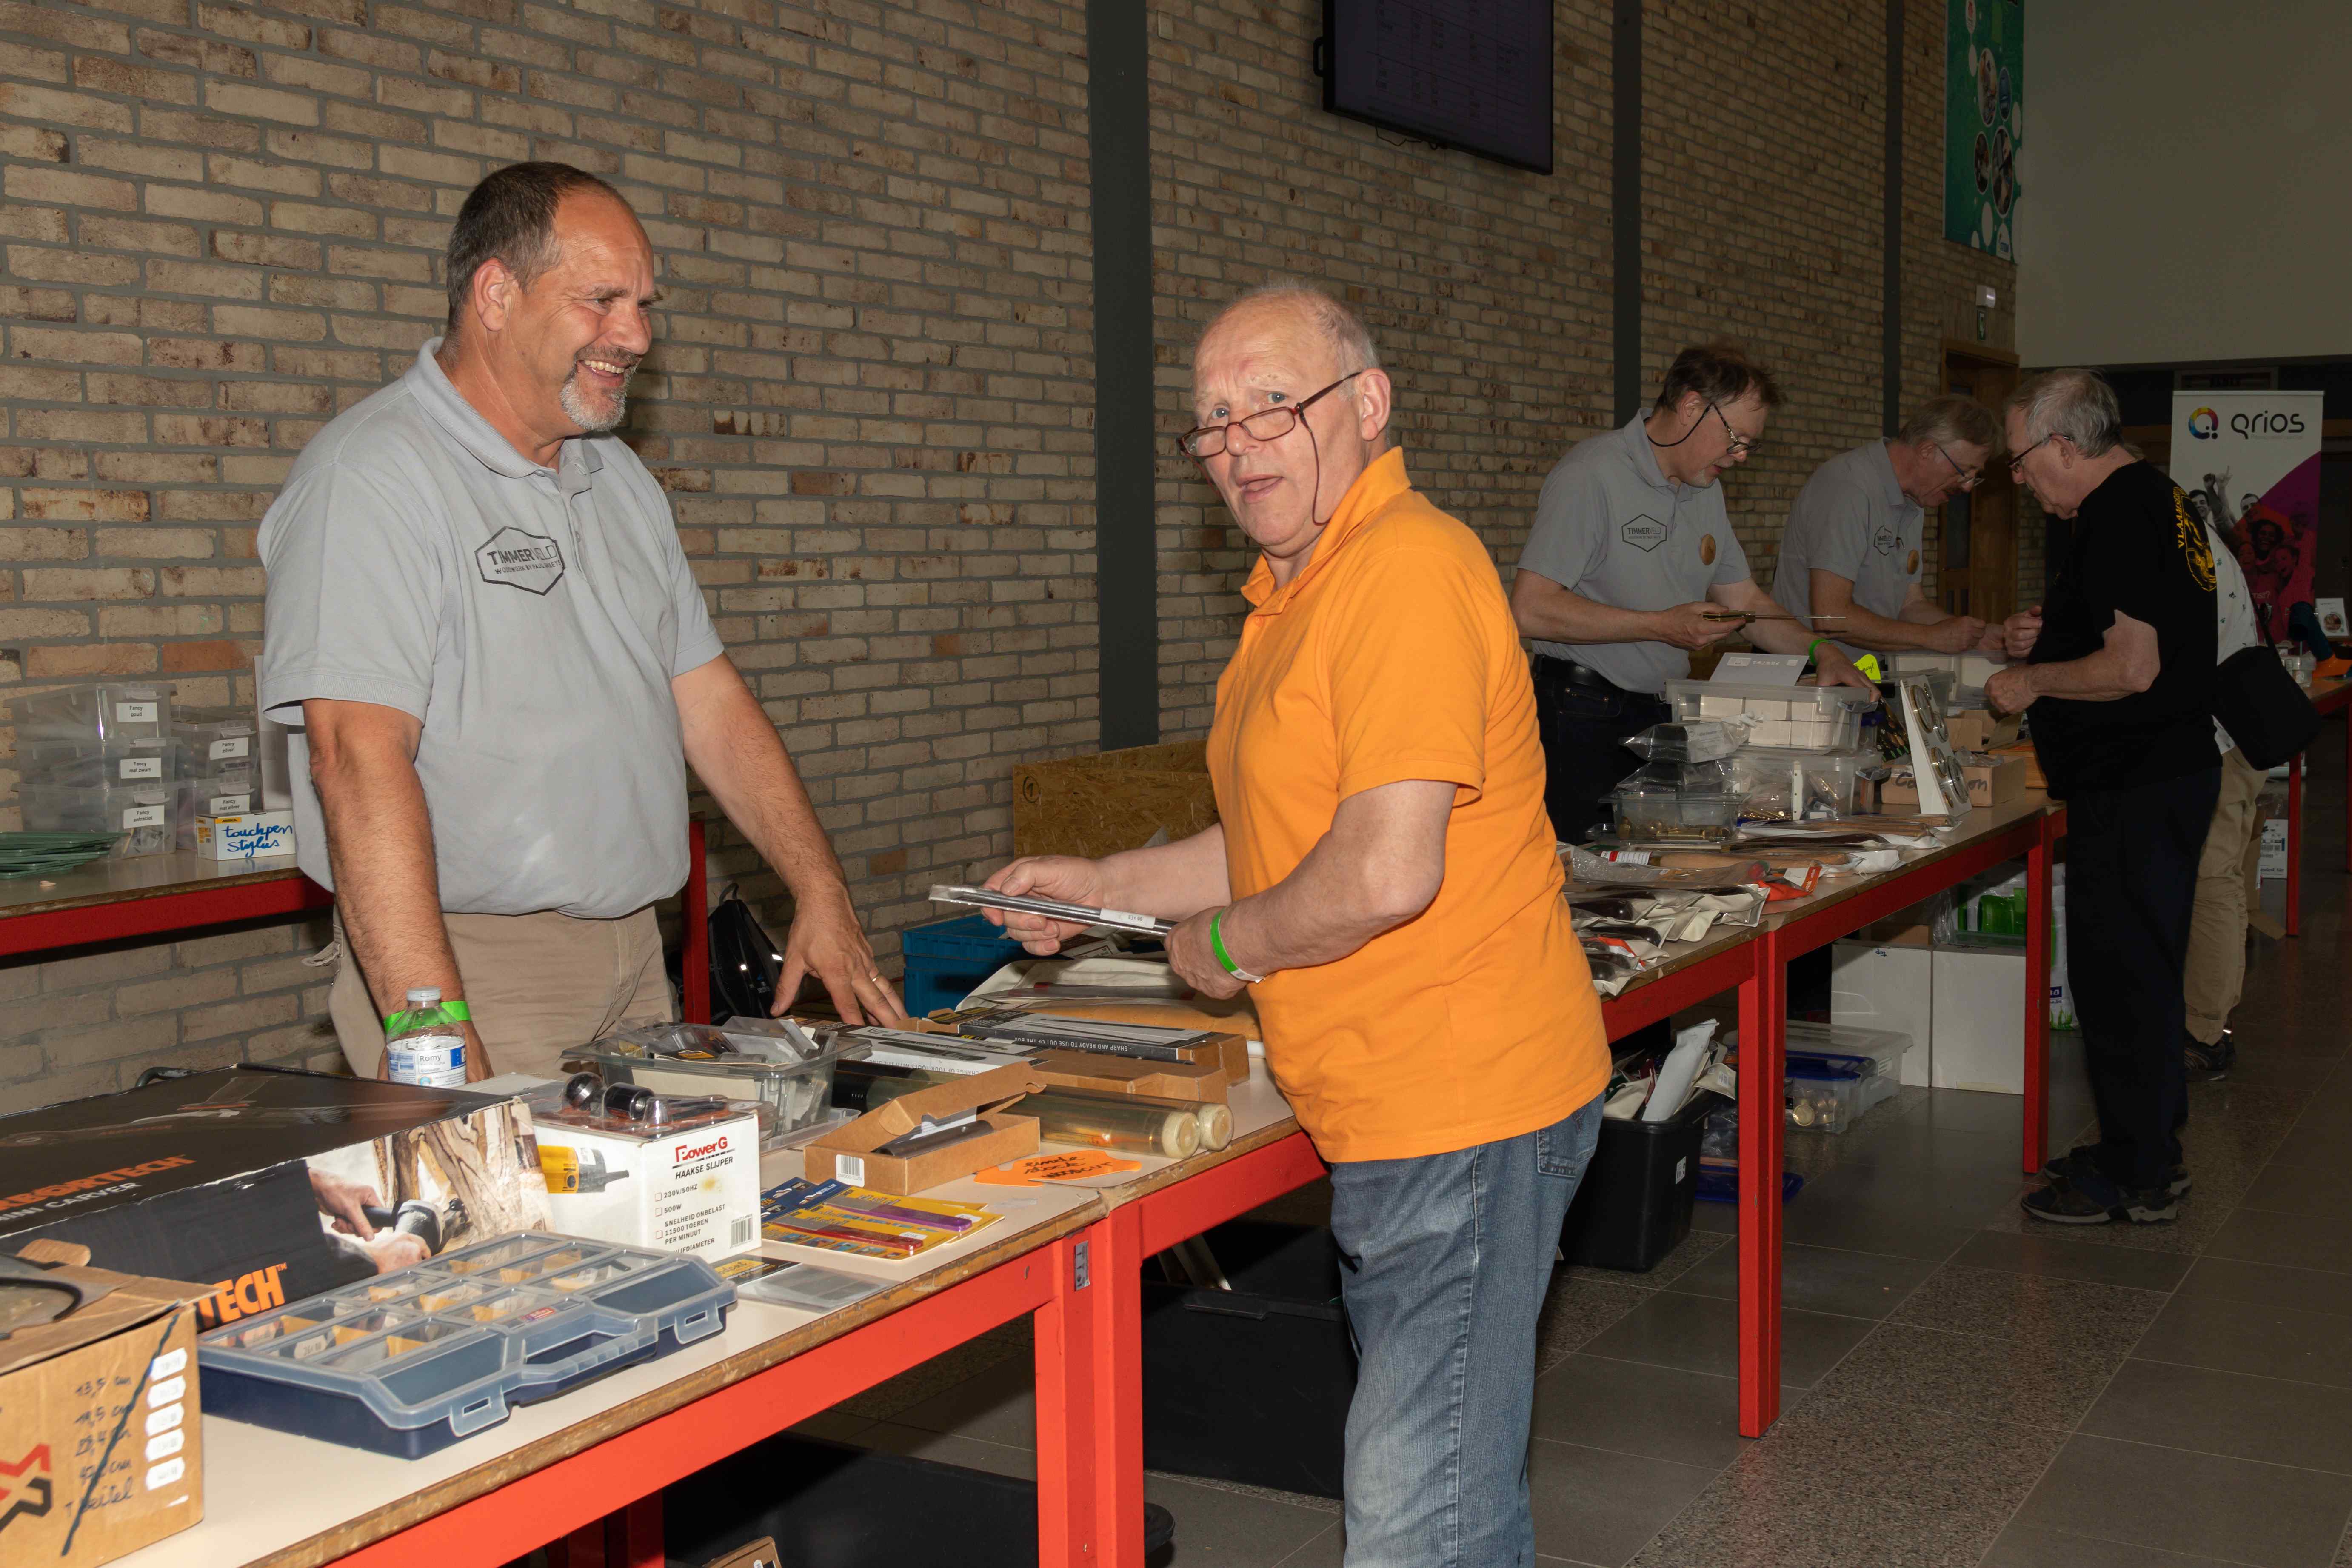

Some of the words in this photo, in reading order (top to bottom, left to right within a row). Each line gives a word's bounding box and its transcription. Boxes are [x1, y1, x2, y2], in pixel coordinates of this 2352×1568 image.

[487, 545, 557, 566] TIMMERVELD
[221, 823, 293, 841] touchpen
[420, 1054, 442, 1062] Romy
[675, 1165, 704, 1179] HAAKSE
[706, 1157, 733, 1171] SLIJPER
[45, 1182, 145, 1208] CARVER
[664, 1184, 698, 1198] 230V/50HZ
[664, 1204, 682, 1213] 500W
[665, 1214, 695, 1227] SNELHEID
[696, 1204, 725, 1217] ONBELAST
[665, 1226, 684, 1236] 11500
[686, 1218, 708, 1229] TOEREN
[665, 1236, 677, 1245] PER
[678, 1229, 701, 1241] MINUUT
